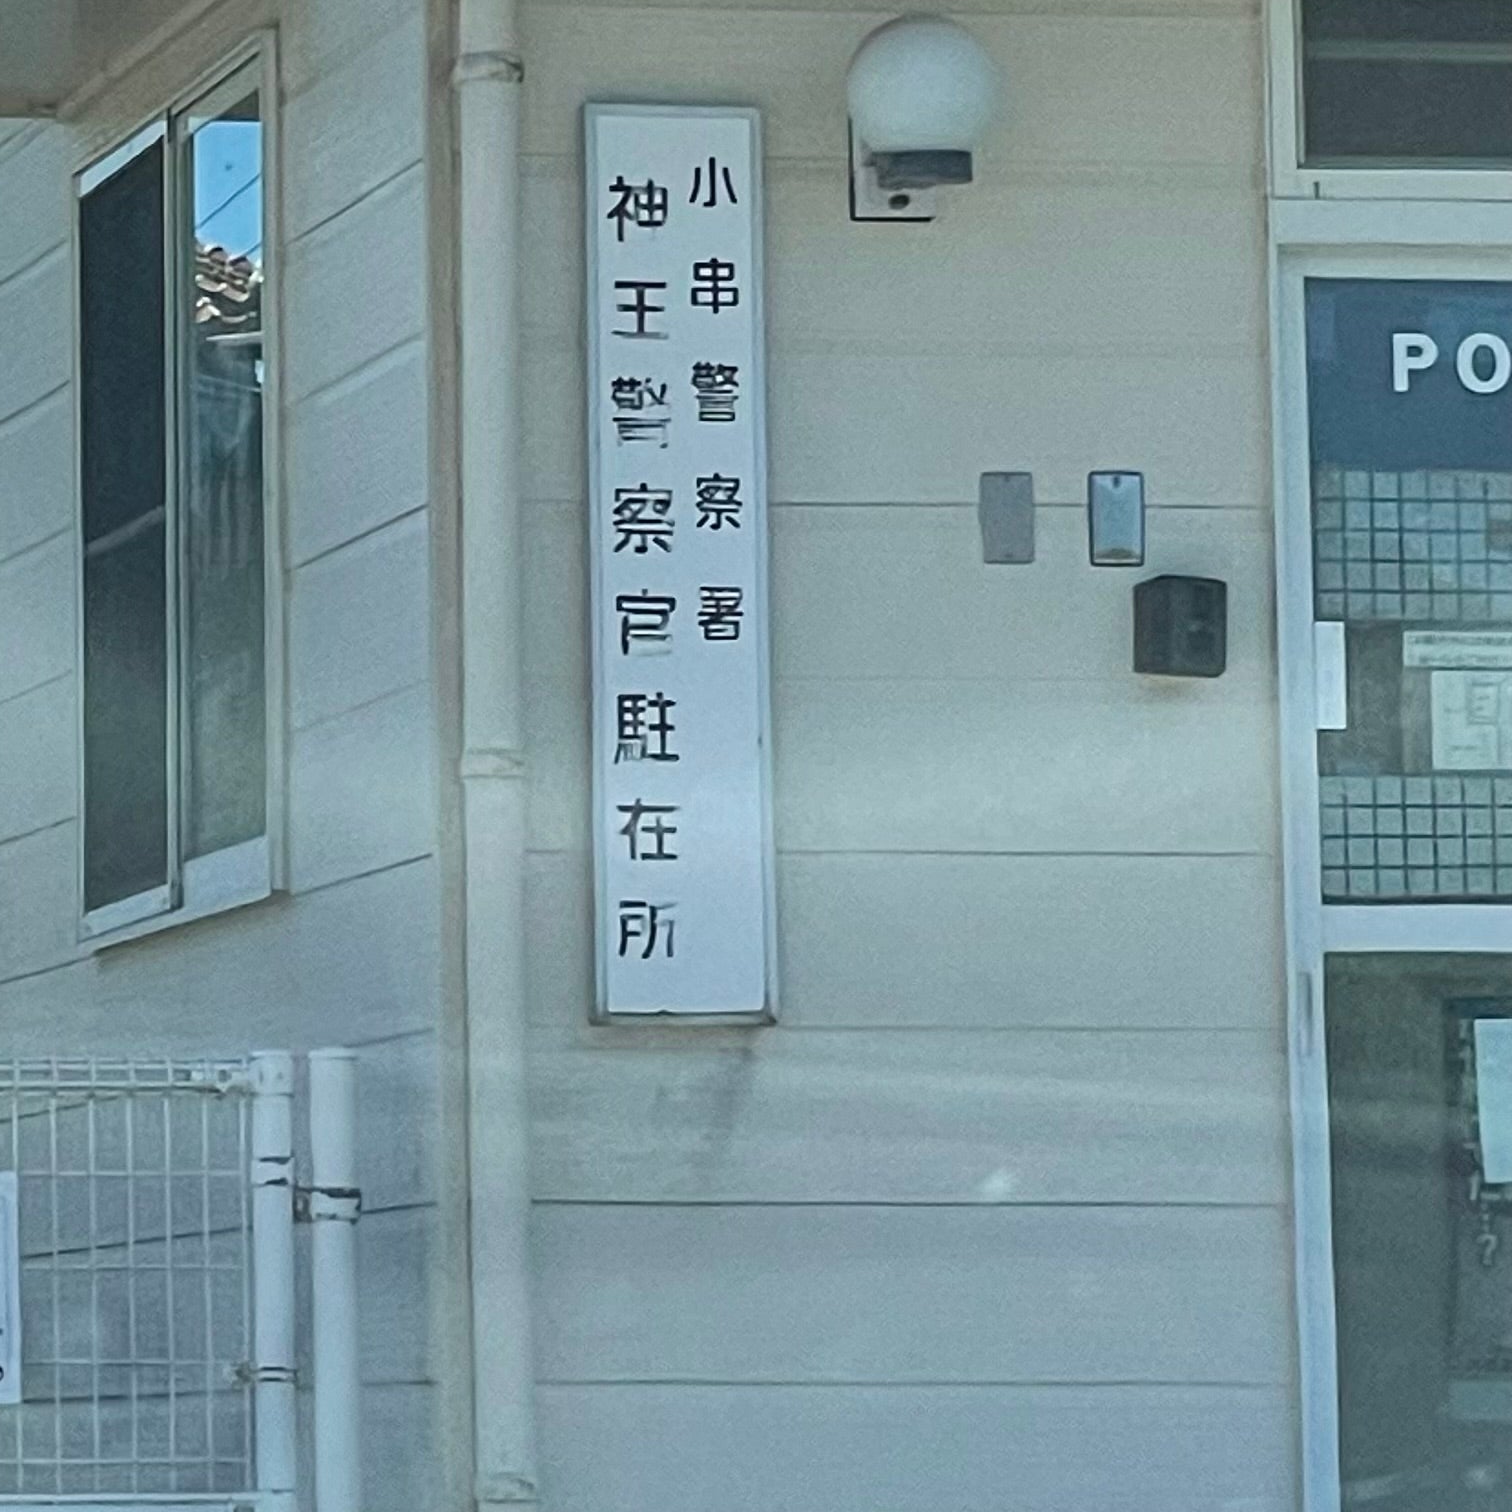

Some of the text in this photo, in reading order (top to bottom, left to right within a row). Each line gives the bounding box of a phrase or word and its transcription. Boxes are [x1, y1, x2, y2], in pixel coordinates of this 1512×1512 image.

[688, 156, 744, 641] 小串警察署
[1391, 332, 1512, 393] PO
